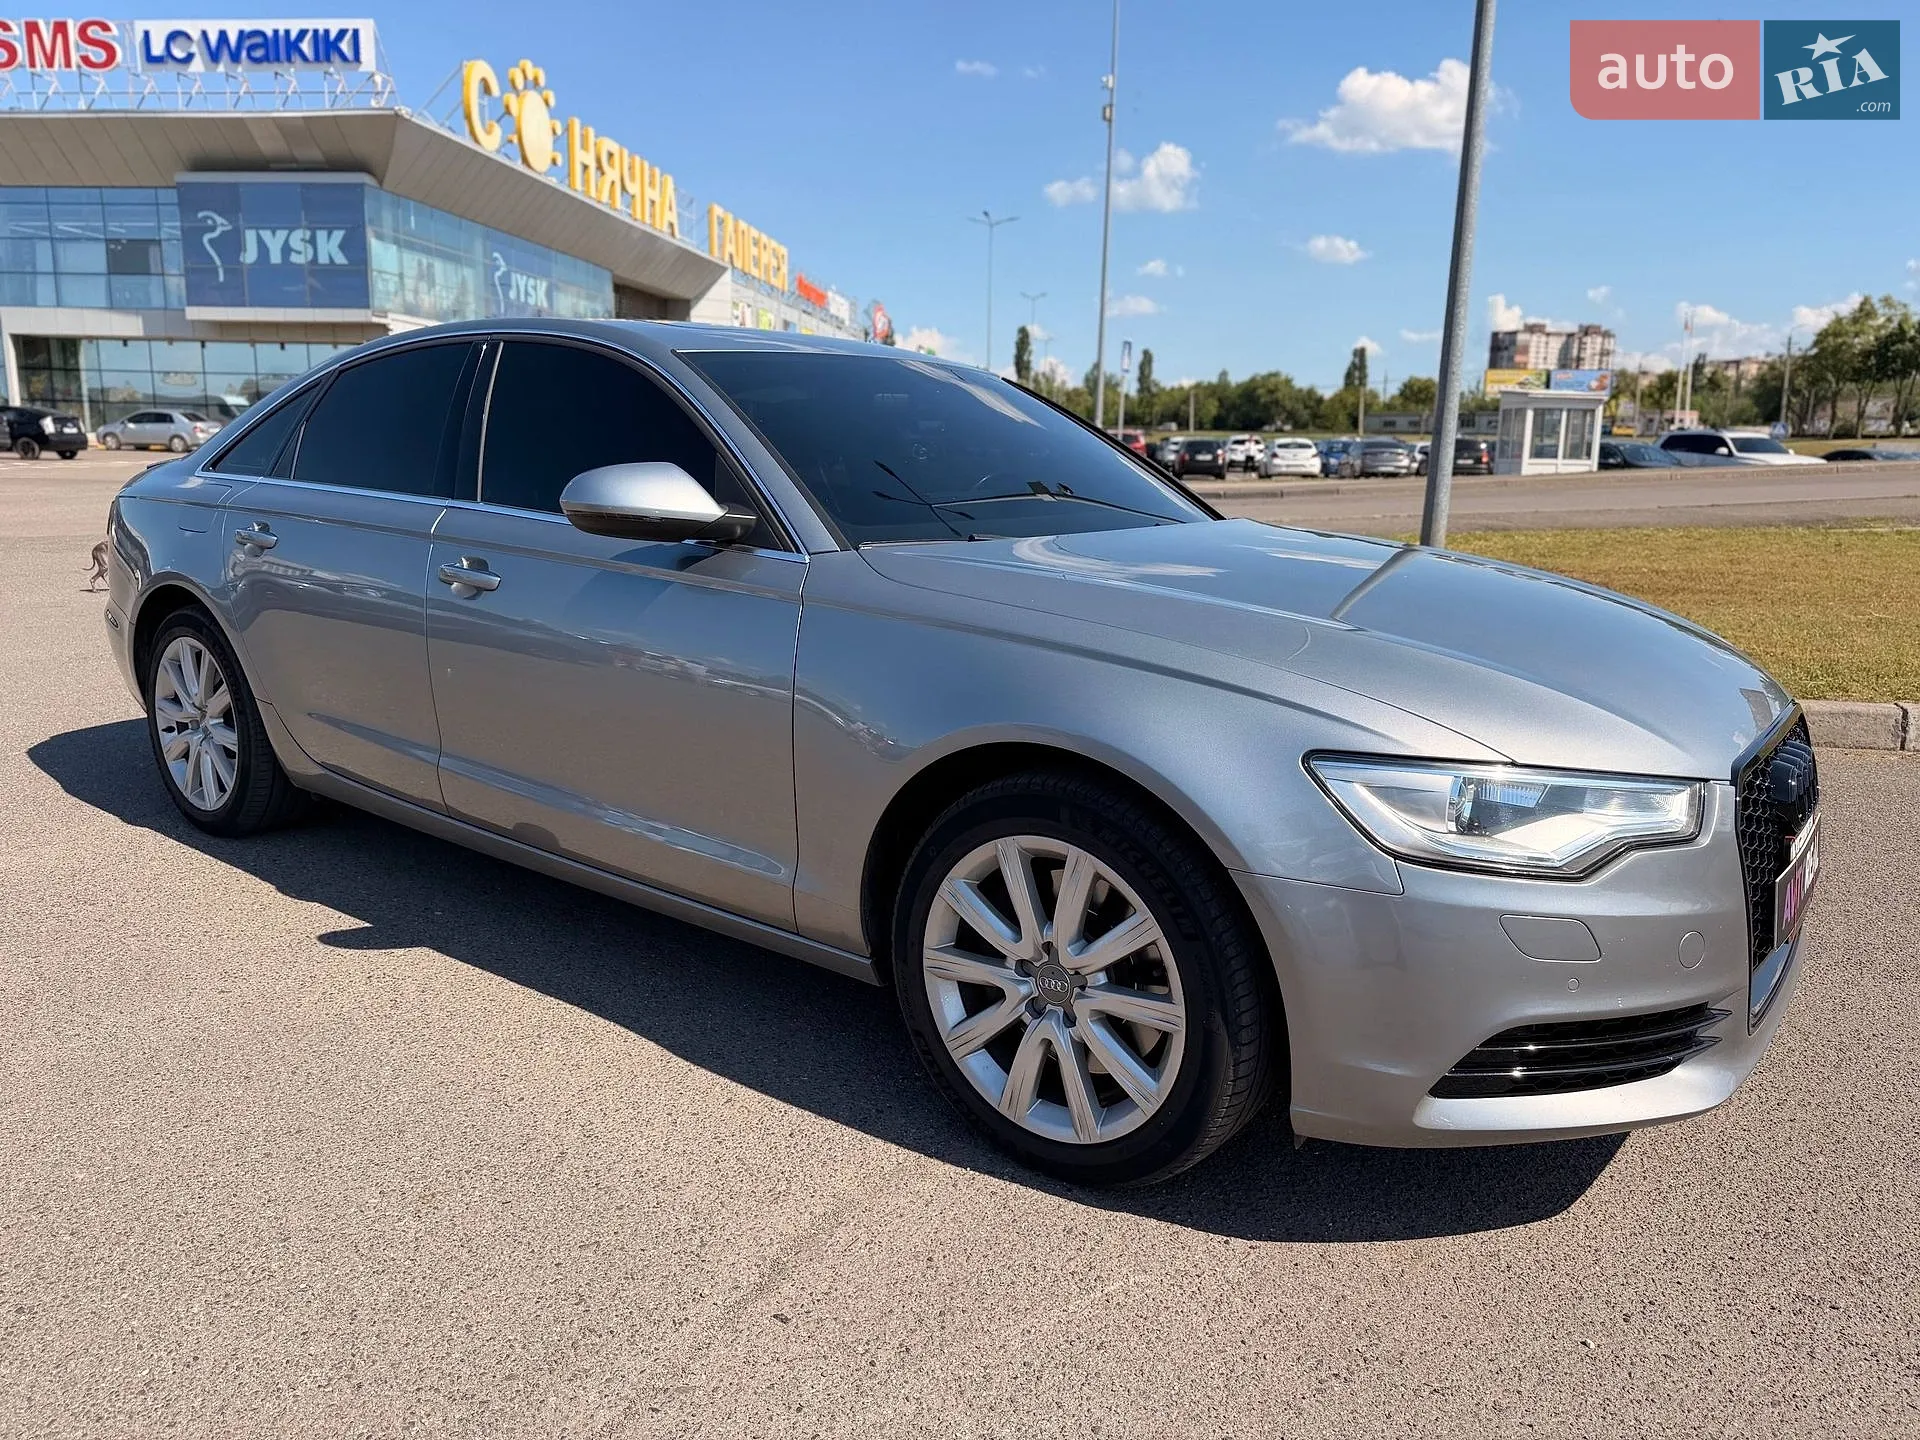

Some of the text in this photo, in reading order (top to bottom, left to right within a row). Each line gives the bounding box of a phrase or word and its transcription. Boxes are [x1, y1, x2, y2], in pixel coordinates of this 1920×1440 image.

[143, 28, 194, 65] LC
[239, 228, 349, 265] JYSK
[708, 202, 788, 293] ГАЛЕРЕЯ
[509, 271, 549, 308] JYSK
